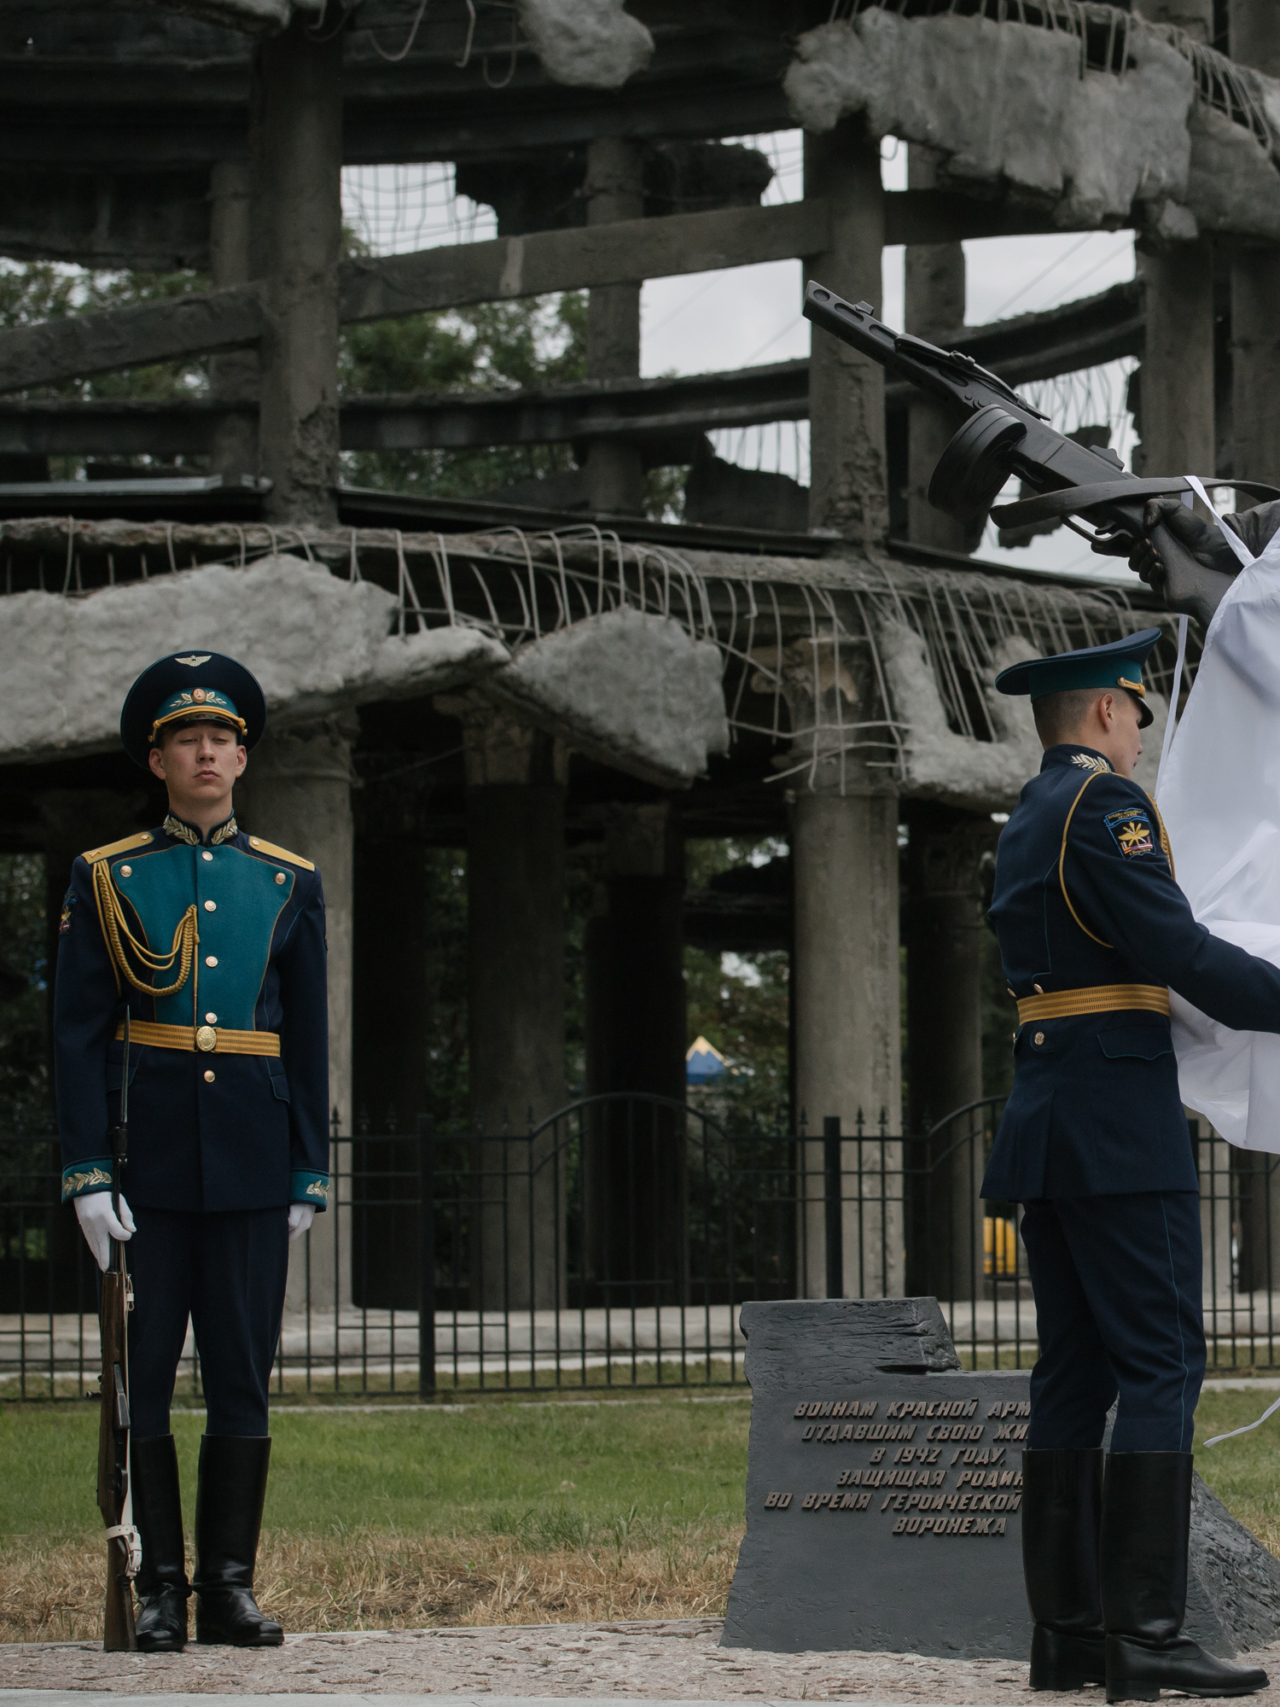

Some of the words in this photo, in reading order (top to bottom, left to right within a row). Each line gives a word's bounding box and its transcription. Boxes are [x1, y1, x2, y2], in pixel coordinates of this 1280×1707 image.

[793, 1401, 879, 1419] ВОИНАМ
[886, 1397, 979, 1420] КРАСНОЙ
[987, 1401, 1031, 1420] АРМ
[801, 1424, 918, 1444] ОТДАВШИМ
[926, 1424, 985, 1442] СВОЮ
[992, 1423, 1029, 1442] ЖИ
[869, 1447, 887, 1465] В
[893, 1447, 943, 1464] 1942
[950, 1447, 1007, 1467] ГОДУ,
[836, 1469, 947, 1488] ЗАЩИЩАЯ
[956, 1470, 1024, 1490] РОДИН
[764, 1491, 794, 1509] ВО
[801, 1492, 873, 1512] ВРЕМЯ
[880, 1489, 1023, 1513] ГЕРОИЧЕСКОЙ
[892, 1516, 1007, 1537] ВОРОНЕЖА
